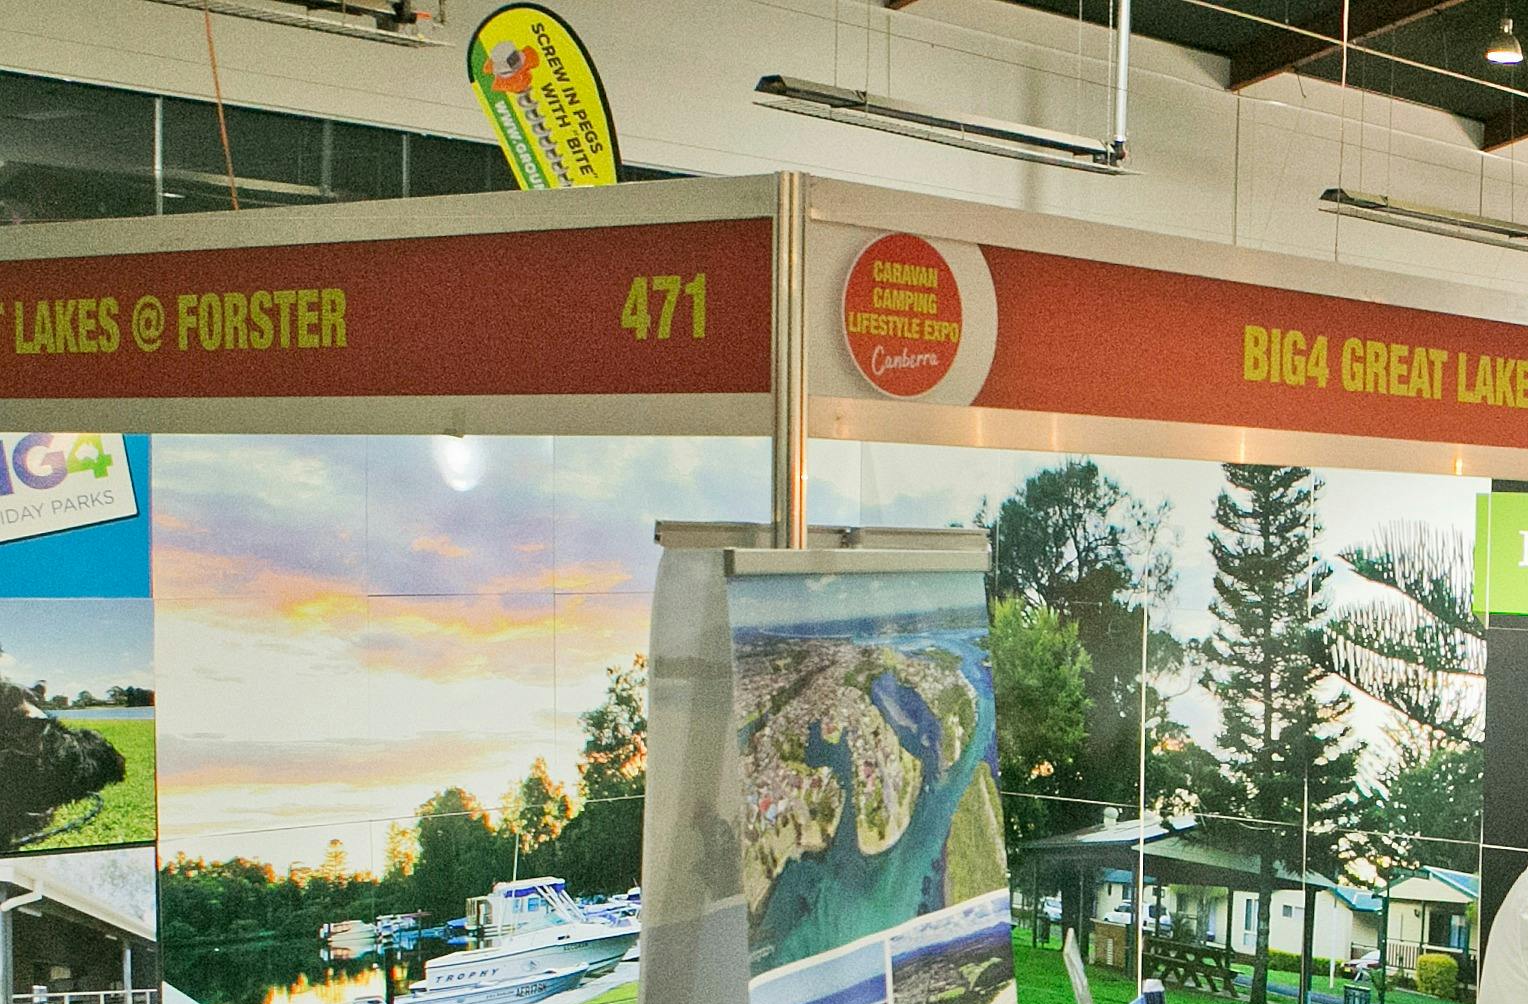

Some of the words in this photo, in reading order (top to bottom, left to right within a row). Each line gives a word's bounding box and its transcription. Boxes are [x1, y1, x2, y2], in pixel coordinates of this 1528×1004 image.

[531, 22, 571, 84] SCREW
[562, 85, 580, 107] IN
[573, 109, 604, 154] PEGS
[541, 81, 571, 128] WITH
[873, 260, 938, 289] CARAVAN
[621, 272, 706, 340] 471
[872, 287, 938, 315] CAMPING
[14, 296, 121, 355] LAKES
[131, 295, 166, 352] @
[176, 287, 348, 352] FORSTER
[848, 311, 921, 340] LIFESTYLE
[923, 319, 960, 344] EXPO
[871, 345, 939, 376] Canberra
[1242, 324, 1330, 388] BIG4
[1340, 336, 1449, 400] GREAT
[51, 489, 115, 515] PARKS
[436, 967, 500, 985] TROPHY
